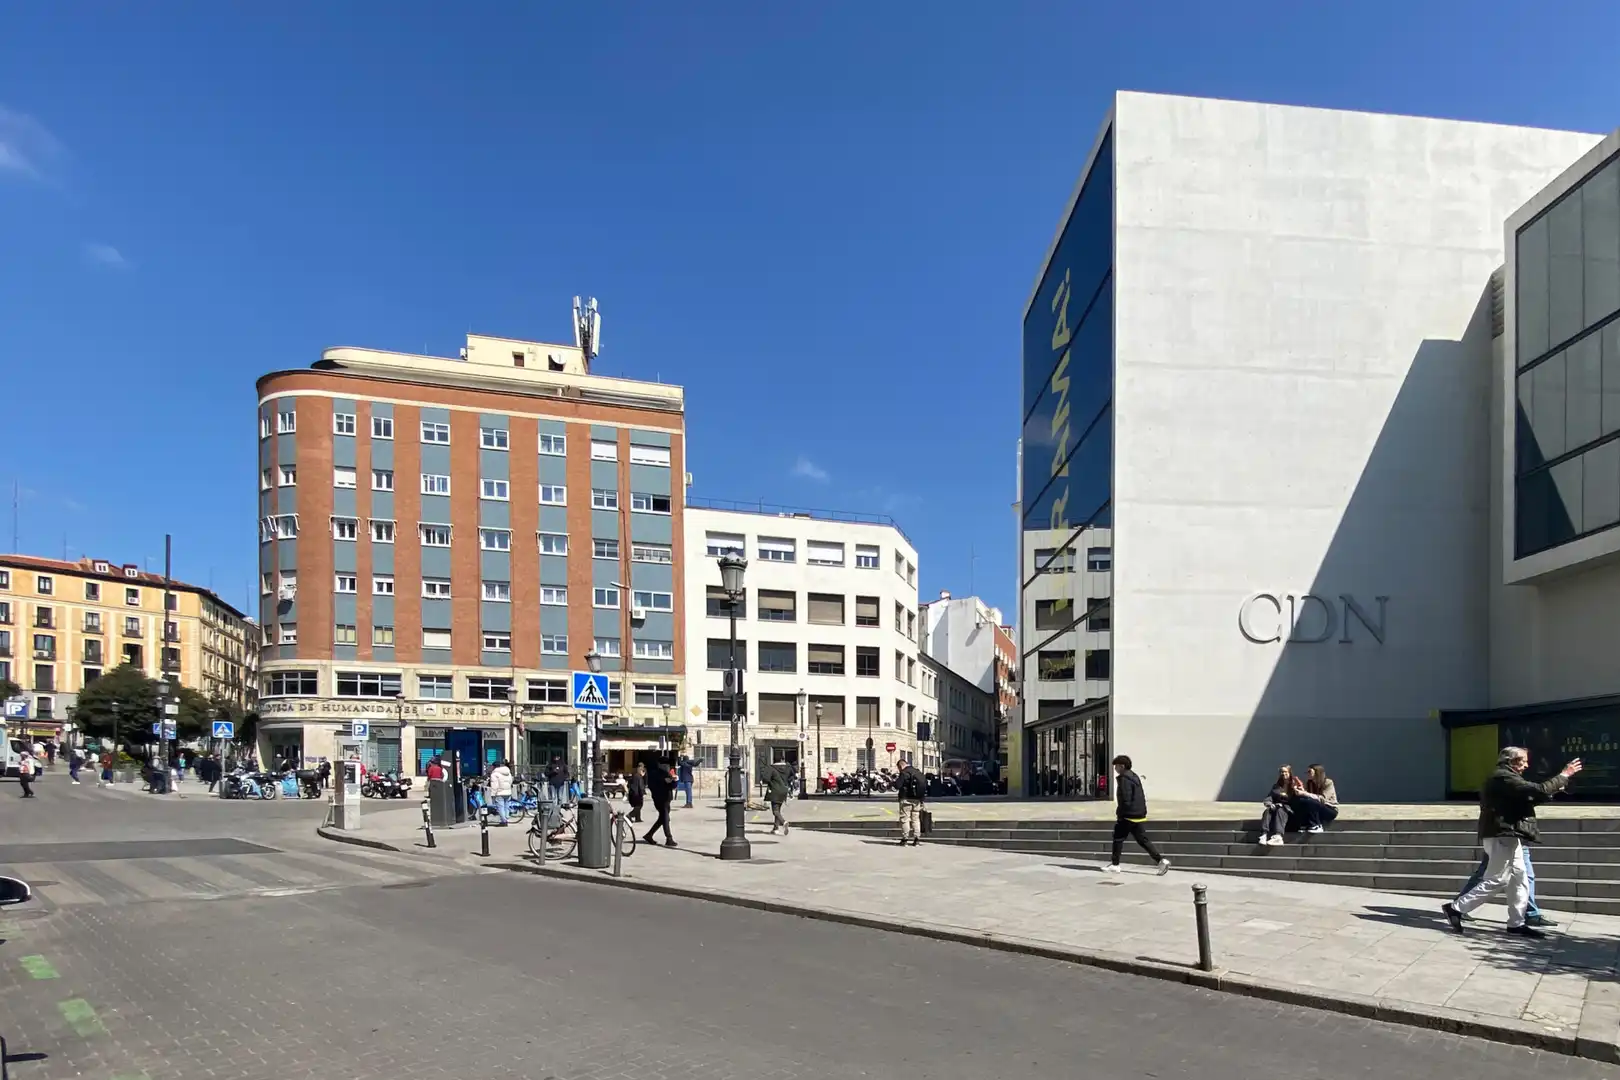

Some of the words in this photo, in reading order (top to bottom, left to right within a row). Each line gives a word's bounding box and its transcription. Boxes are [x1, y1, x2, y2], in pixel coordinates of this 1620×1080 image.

[1238, 593, 1391, 645] CDN
[299, 703, 314, 712] DE
[322, 704, 419, 714] HUMANIDADES
[354, 725, 365, 736] P
